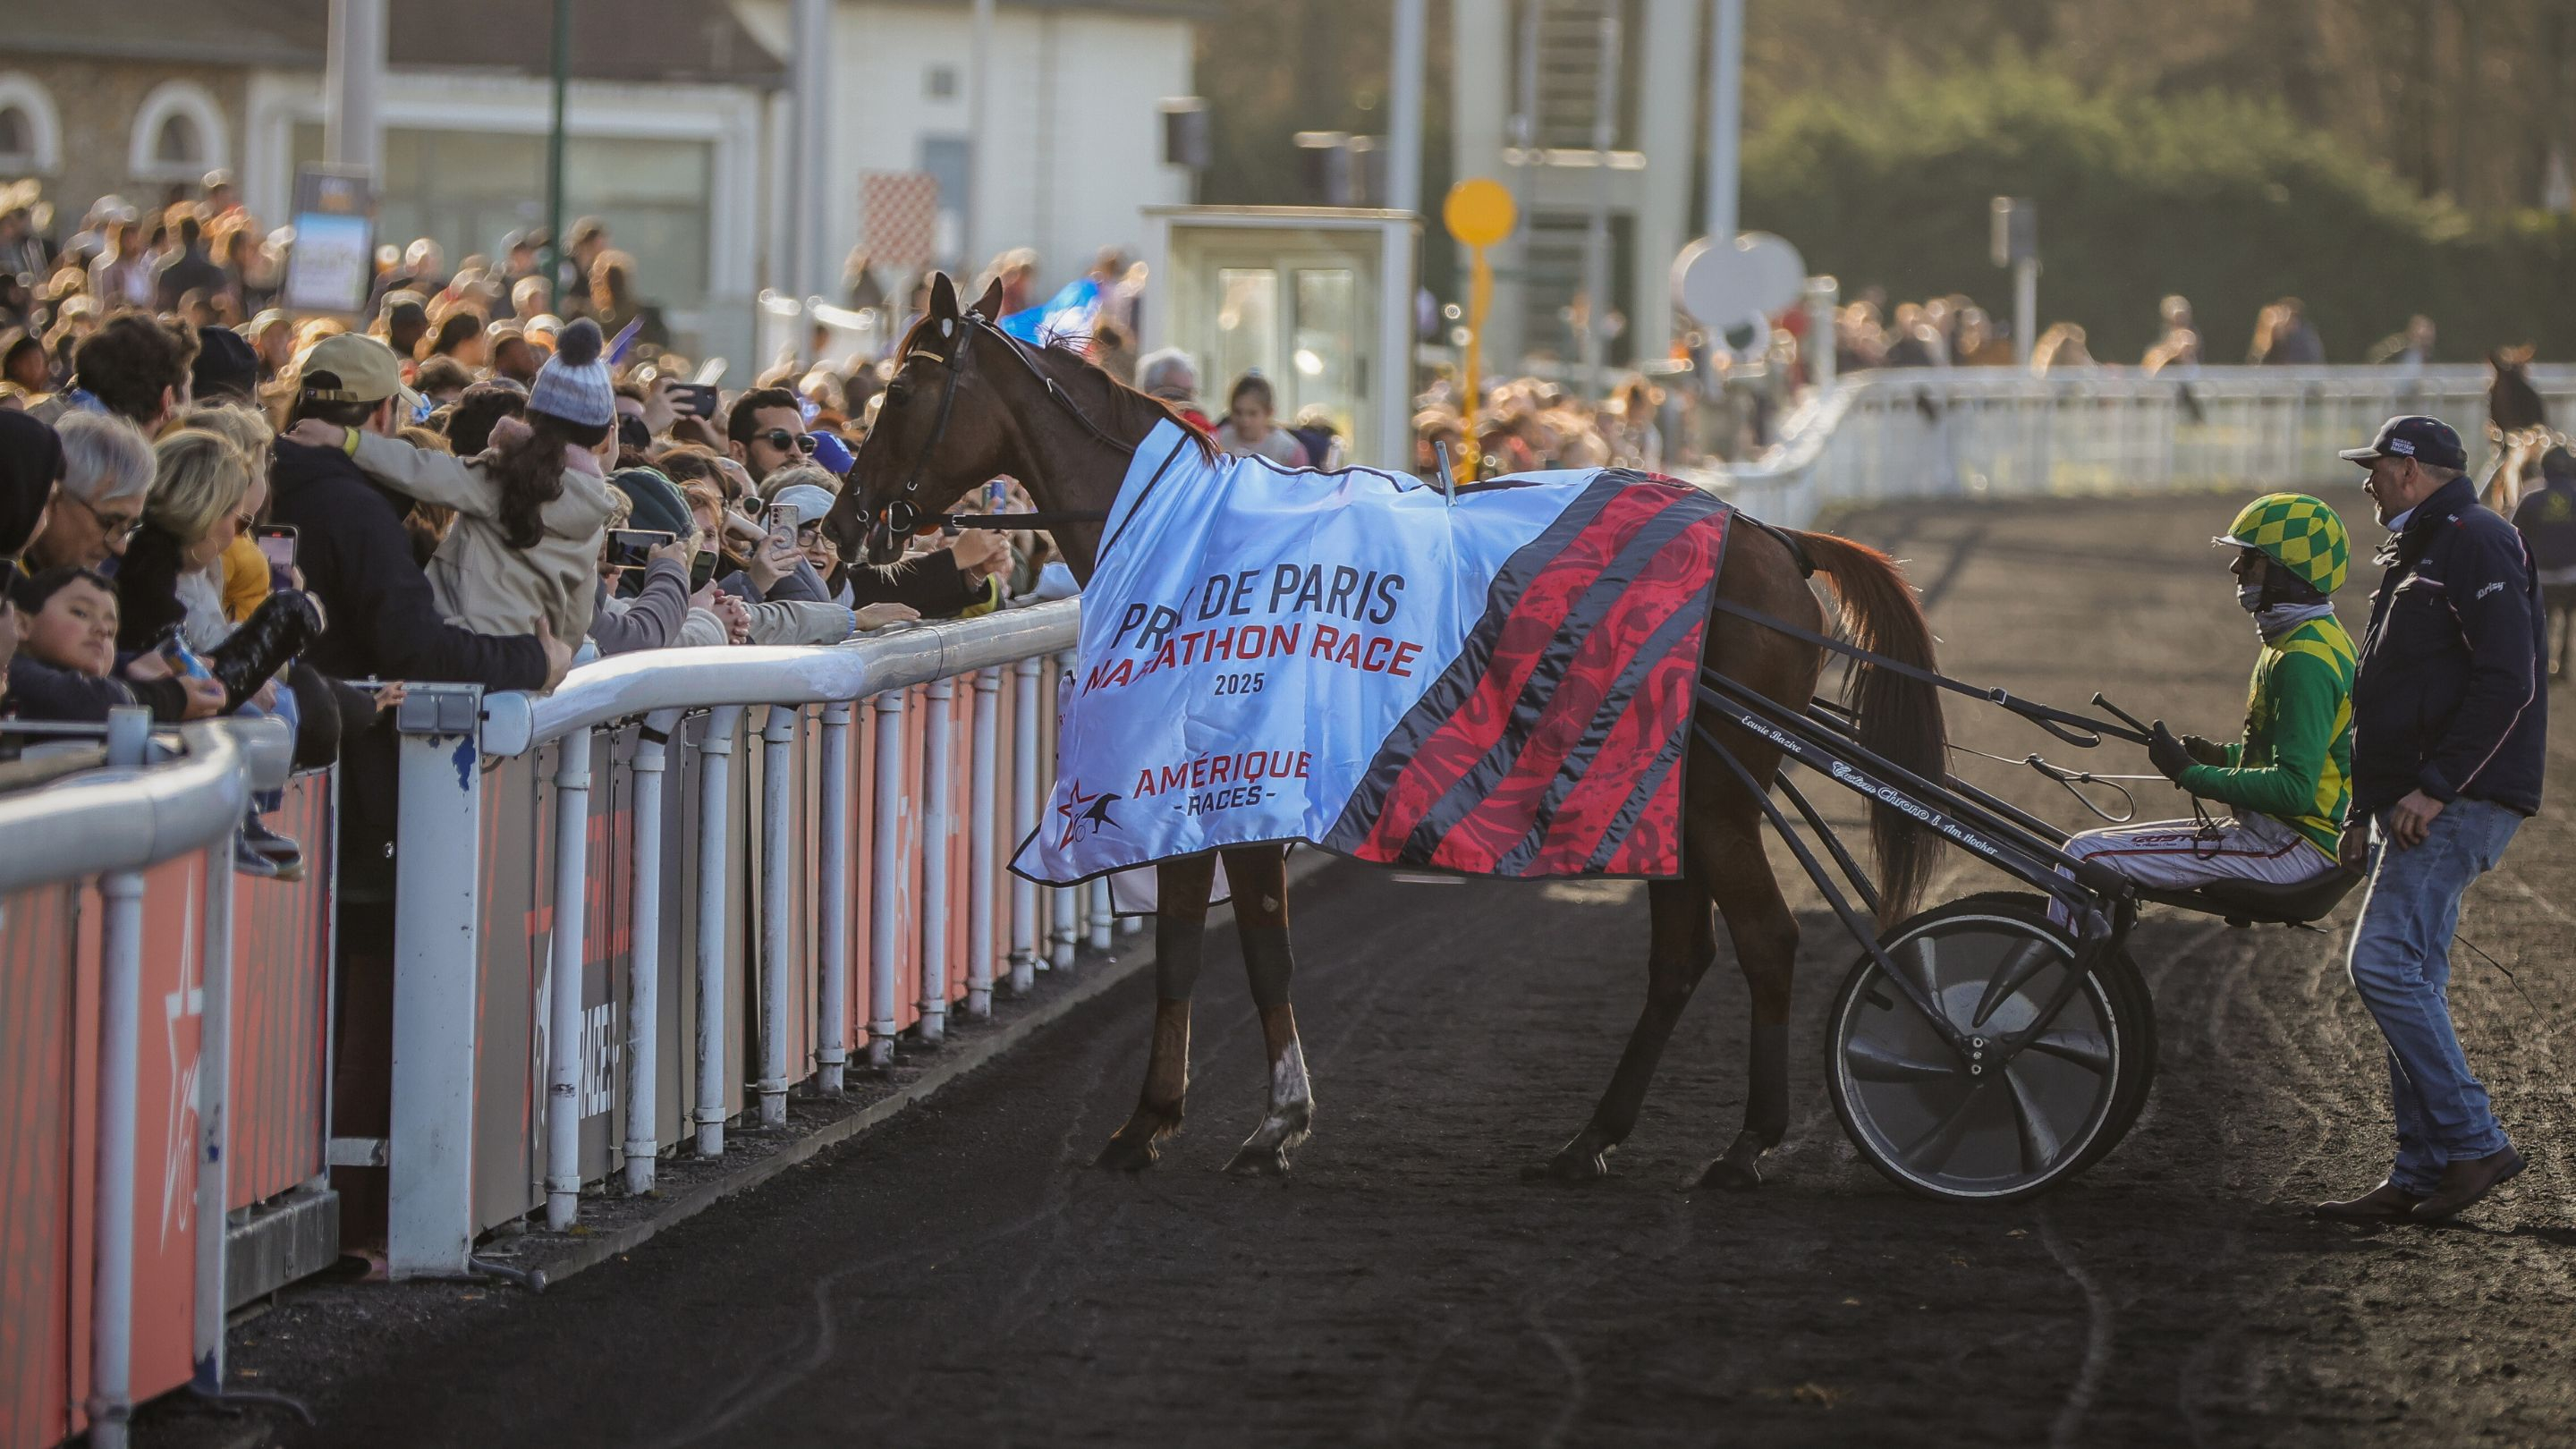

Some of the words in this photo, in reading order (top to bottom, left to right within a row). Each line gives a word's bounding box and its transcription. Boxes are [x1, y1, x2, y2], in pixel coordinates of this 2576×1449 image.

[1110, 586, 1195, 652] PR
[1197, 569, 1261, 622] DE
[1268, 563, 1406, 625] PARIS
[1080, 623, 1300, 699] MAATHON
[1309, 623, 1423, 678] RACE
[1214, 673, 1265, 695] 2025
[1133, 751, 1311, 799] AMÉRIQUE
[1769, 730, 1801, 753] Bazire
[1877, 786, 1929, 821] Chrono
[1962, 833, 1998, 856] Hooker
